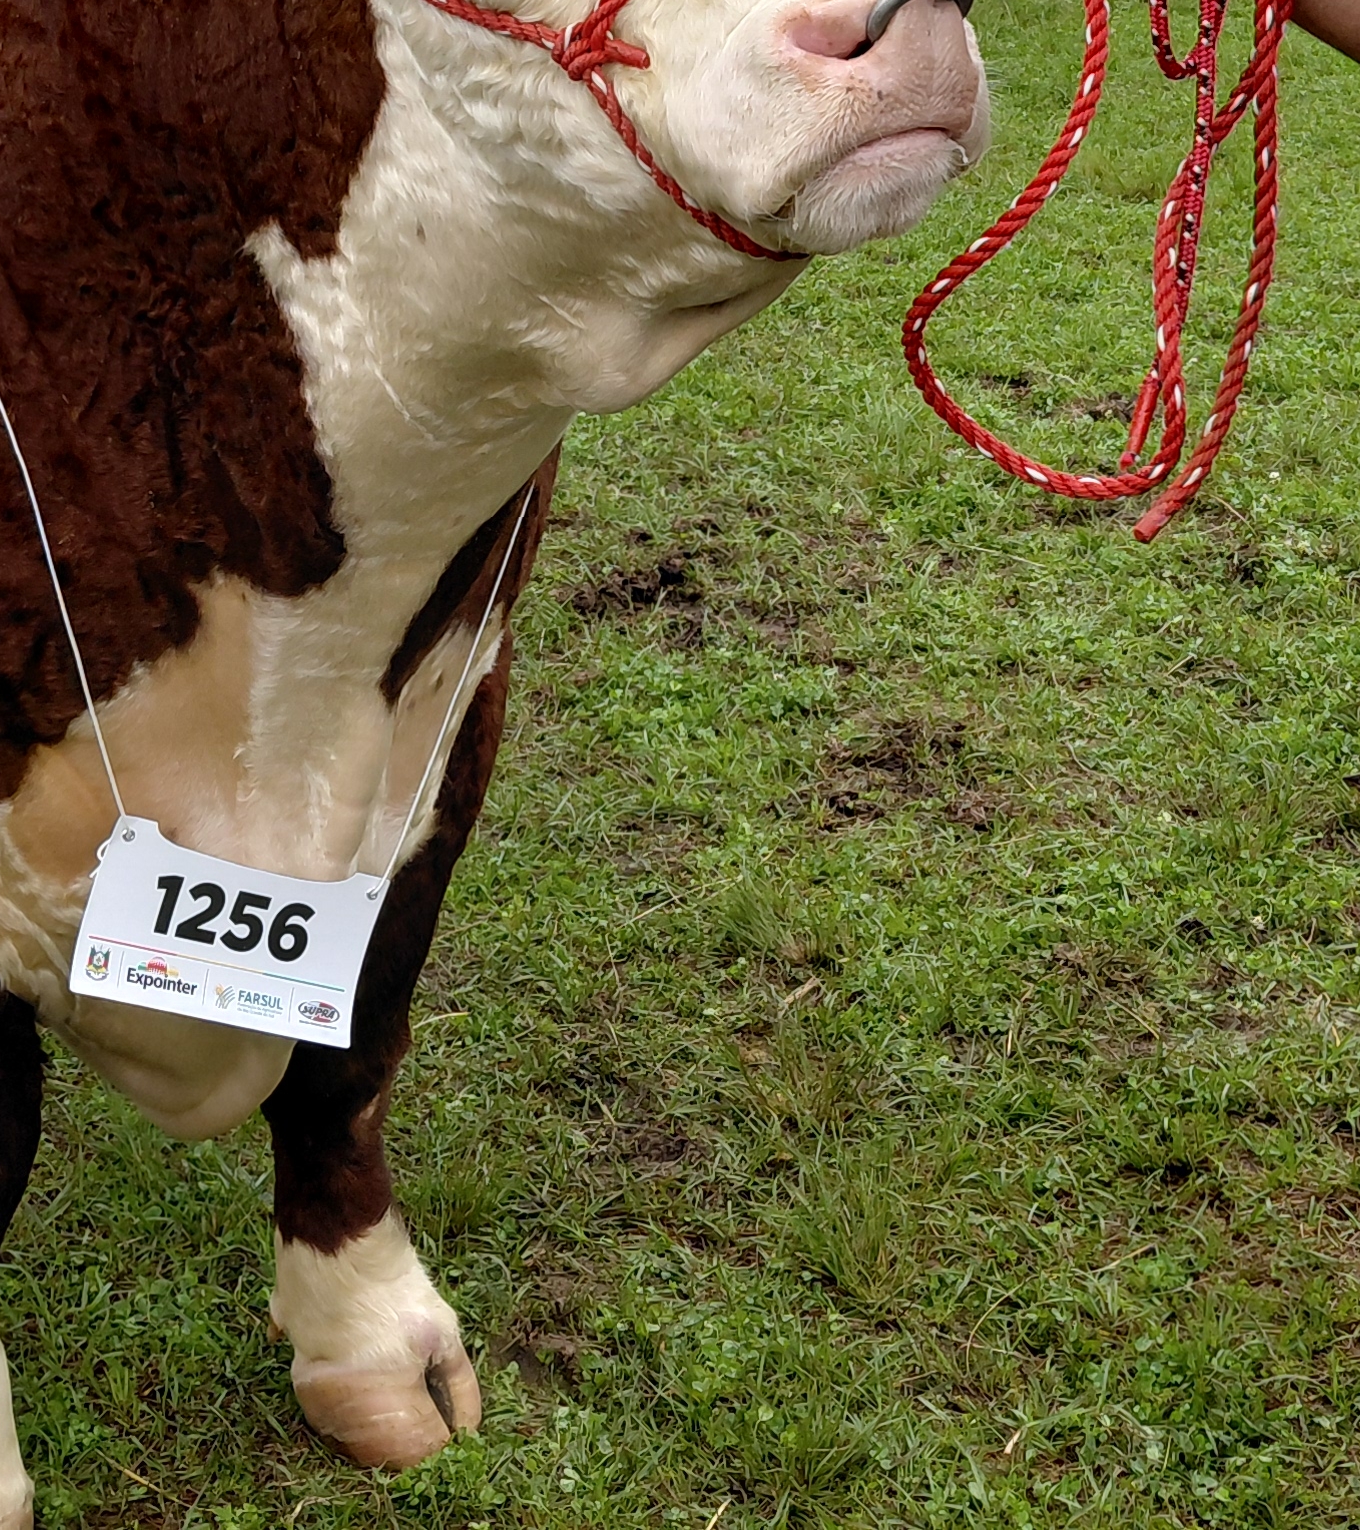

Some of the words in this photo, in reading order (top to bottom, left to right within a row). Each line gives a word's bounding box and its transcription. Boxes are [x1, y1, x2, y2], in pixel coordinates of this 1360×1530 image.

[153, 874, 316, 962] 1256
[126, 967, 198, 996] Expointer
[238, 989, 284, 1011] FARSUL
[301, 1005, 336, 1020] SUPRA
